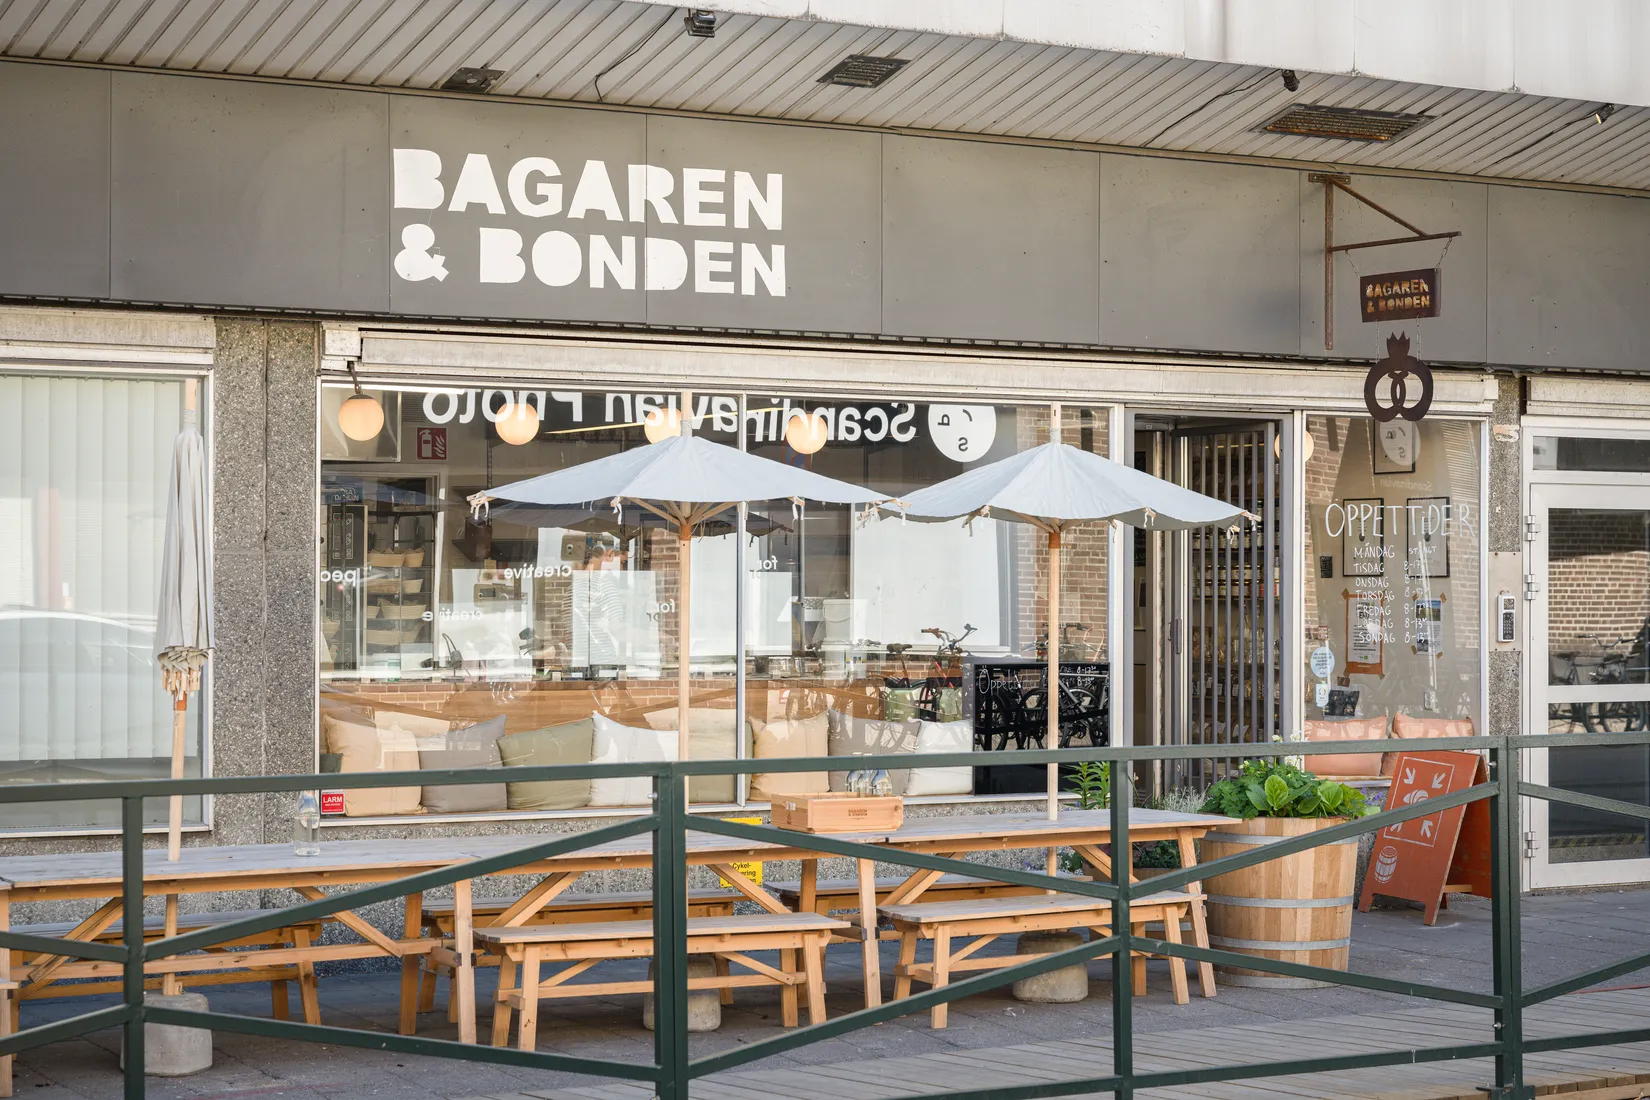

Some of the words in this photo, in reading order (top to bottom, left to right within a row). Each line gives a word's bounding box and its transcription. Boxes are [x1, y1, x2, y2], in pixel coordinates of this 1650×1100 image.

[393, 148, 783, 231] BAGAREN
[393, 223, 449, 282] &
[479, 227, 786, 297] BONDEN
[1366, 279, 1429, 297] BAGAREN
[1379, 295, 1430, 311] BONDEN
[1355, 577, 1389, 588] ONSDAG
[1355, 590, 1395, 601] TORSDAG
[1357, 604, 1391, 617] FREDAG
[732, 862, 752, 870] Cykel-
